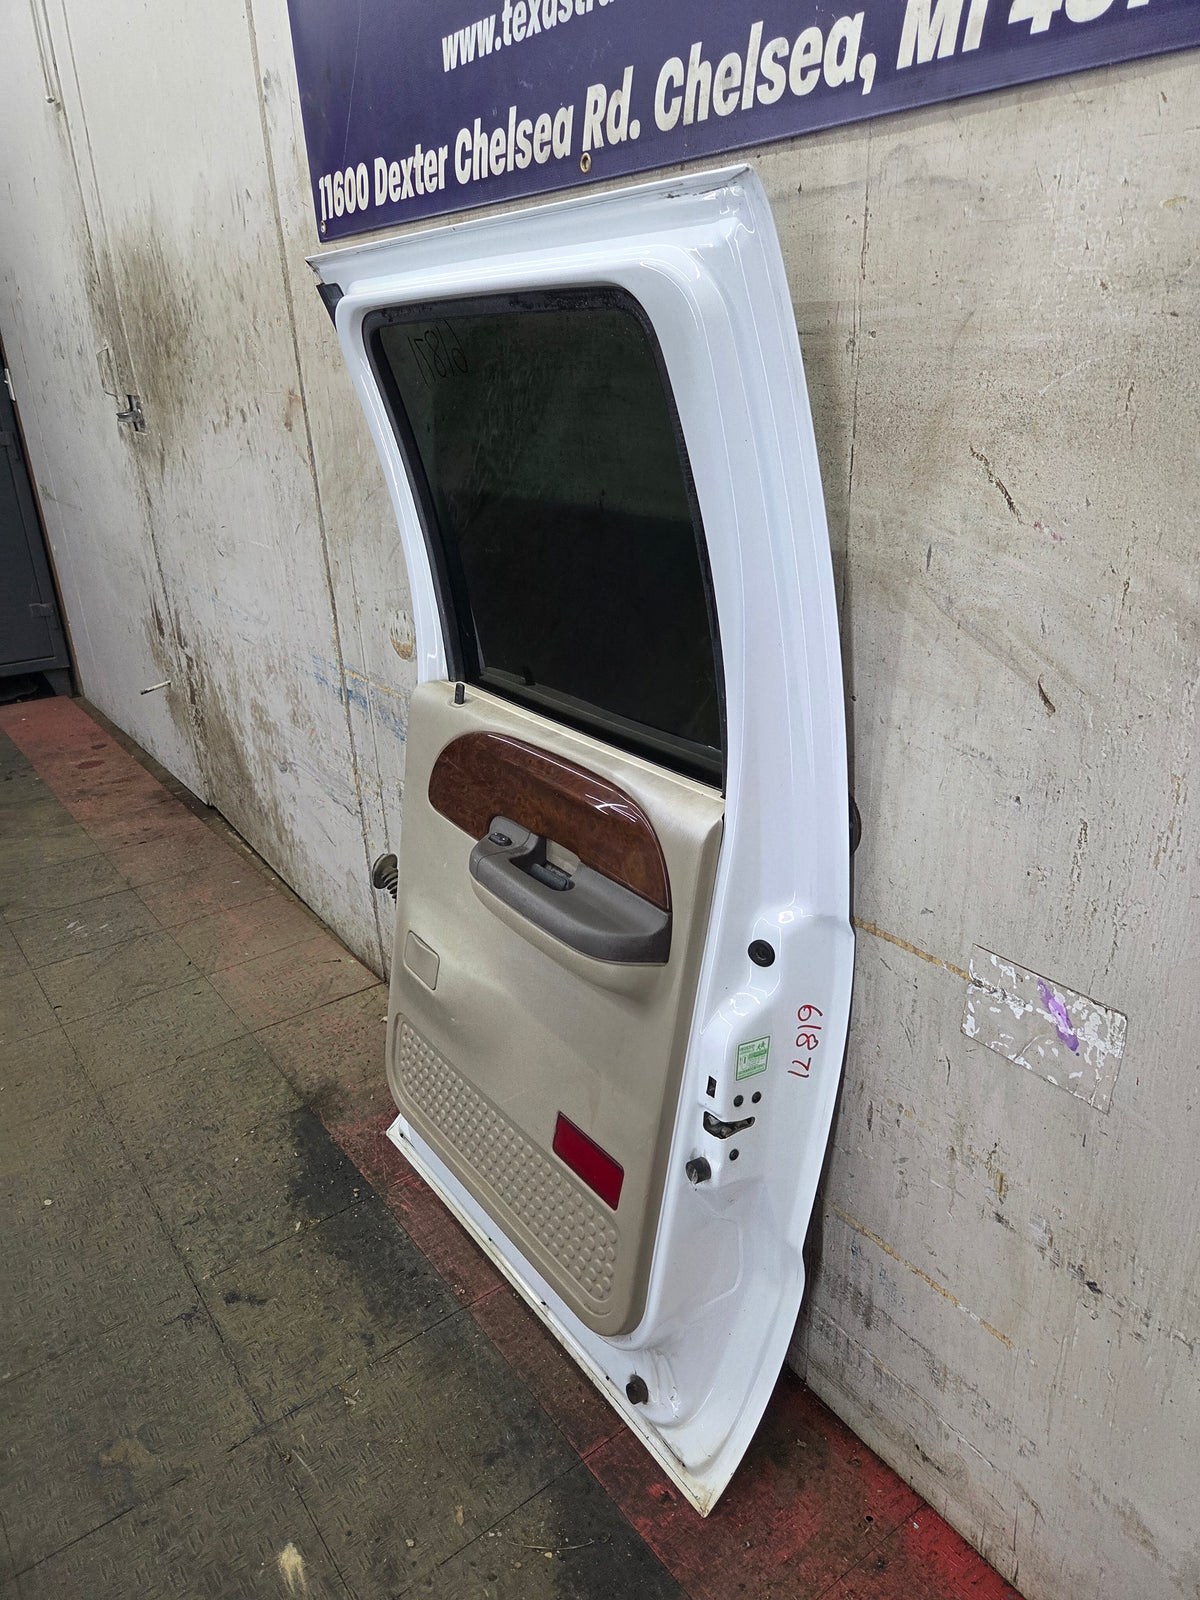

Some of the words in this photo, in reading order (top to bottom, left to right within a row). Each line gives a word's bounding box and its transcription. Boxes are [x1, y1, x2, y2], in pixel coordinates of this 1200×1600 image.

[441, 0, 614, 73] www.texas
[318, 161, 370, 221] 11600
[373, 143, 449, 207] Dexter
[454, 105, 574, 185] Chelsea
[582, 65, 641, 152] Rd.
[654, 10, 878, 133] Chelsea,
[787, 1004, 824, 1079] 61871
